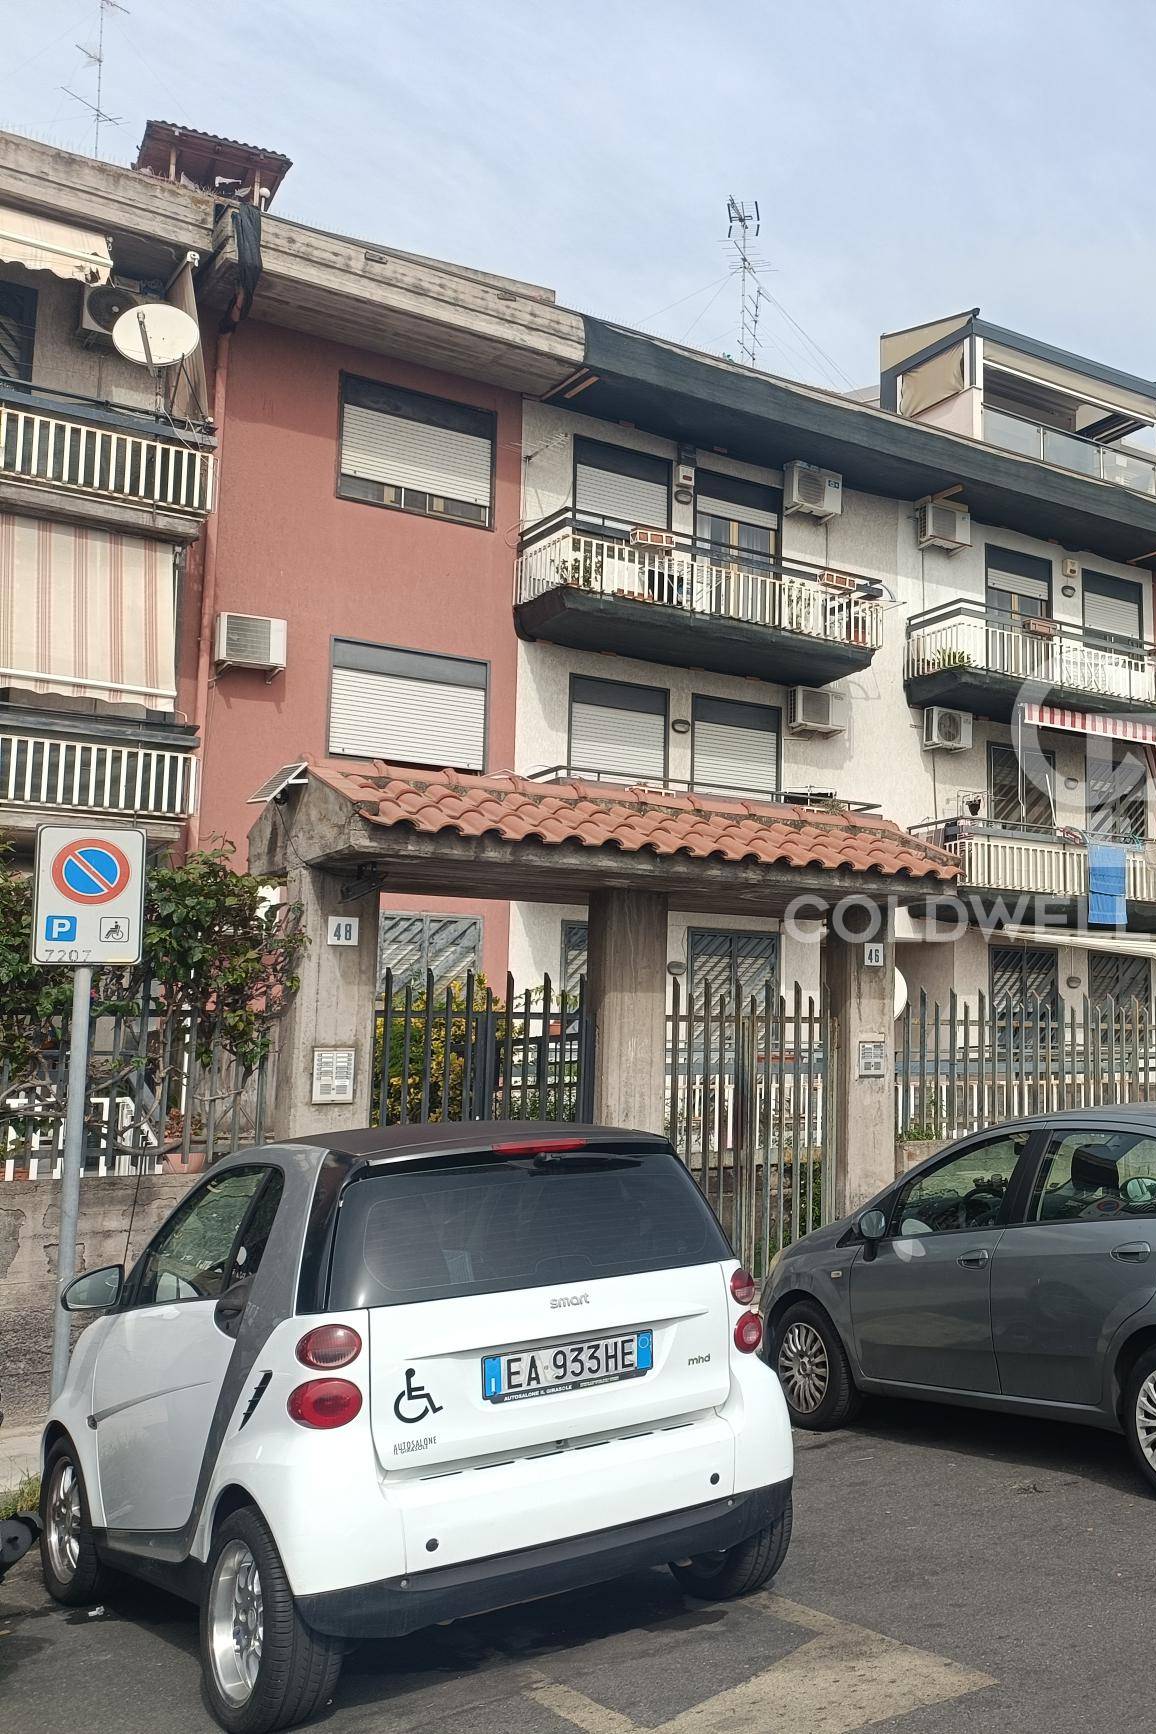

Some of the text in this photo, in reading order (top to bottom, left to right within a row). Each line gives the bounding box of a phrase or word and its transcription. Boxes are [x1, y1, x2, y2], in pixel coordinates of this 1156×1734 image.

[53, 919, 71, 938] P
[332, 922, 352, 941] 48
[44, 949, 92, 963] 7207
[867, 948, 880, 963] 46
[549, 1293, 590, 1309] smart
[506, 1338, 634, 1389] EA 933HE
[687, 1353, 711, 1366] mhd
[503, 1390, 540, 1402] AUTOSALONE
[393, 1436, 437, 1451] AUTOSALONE
